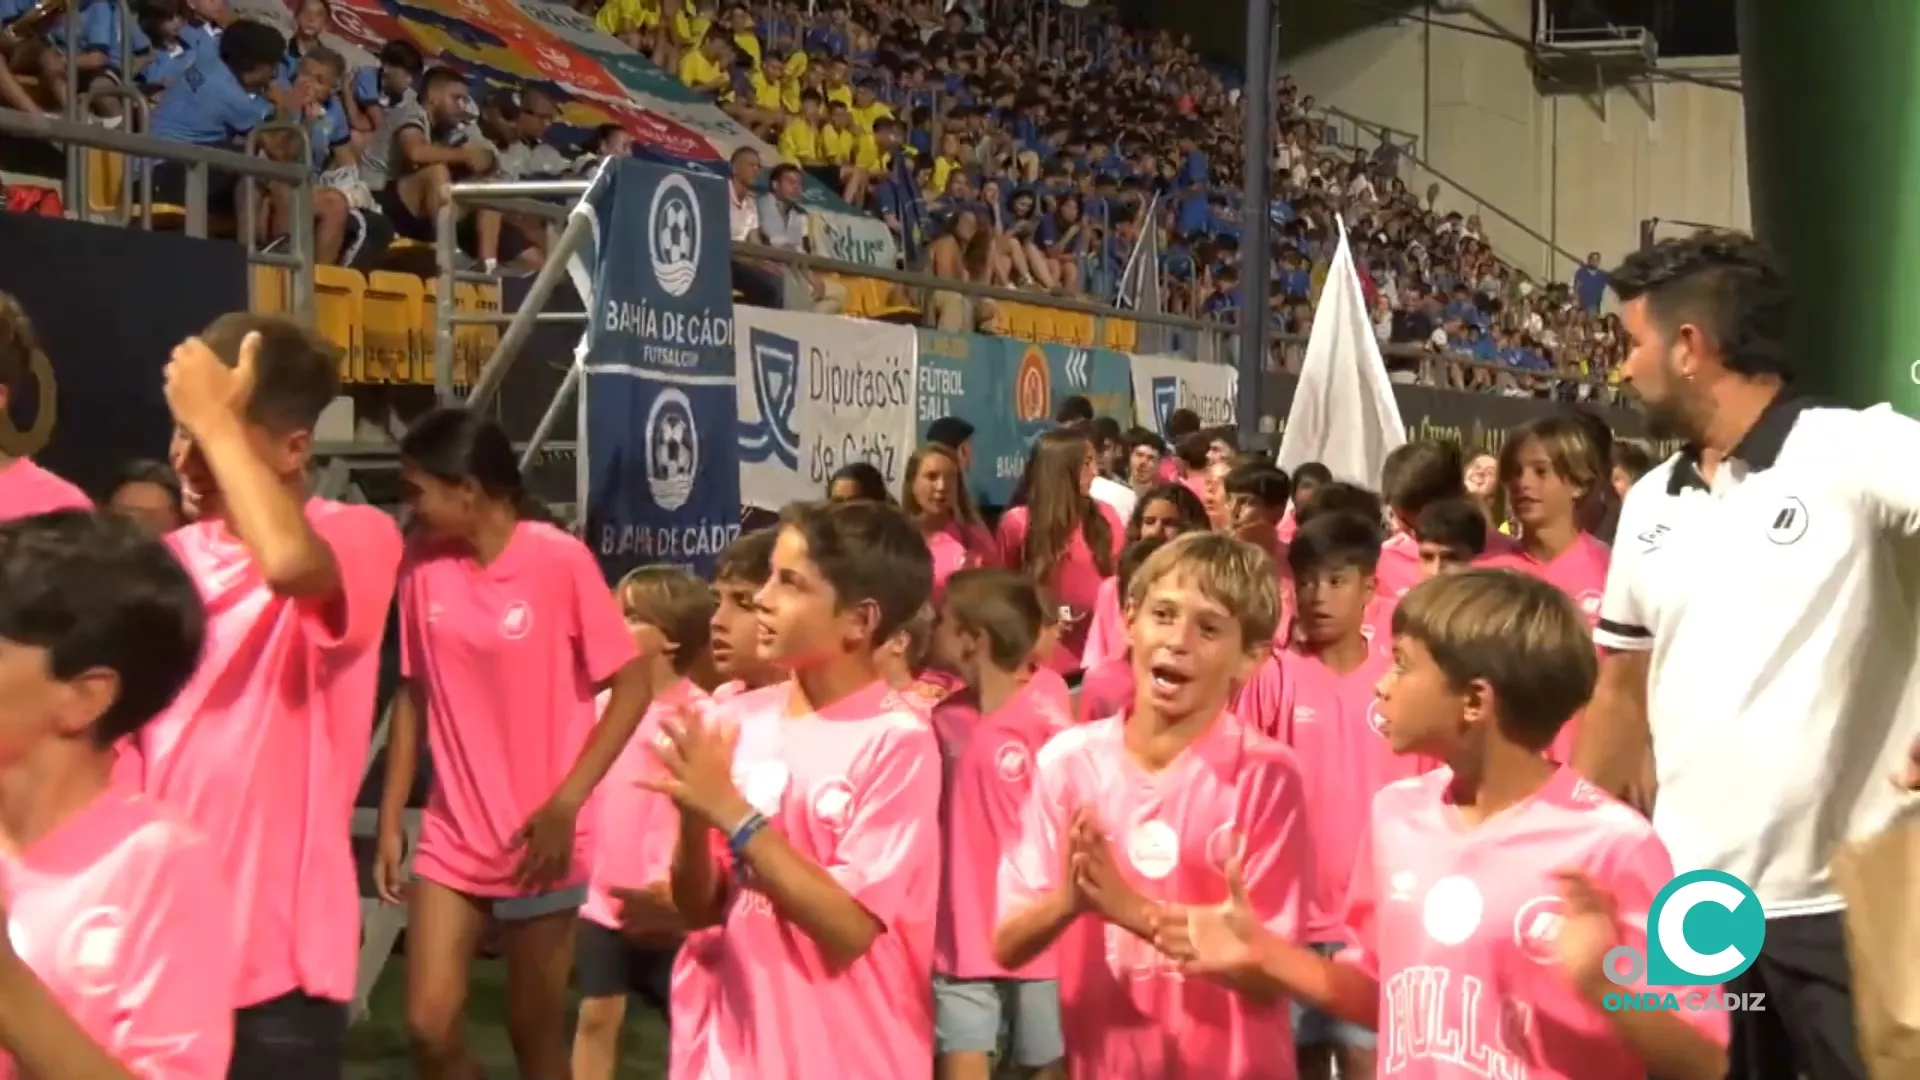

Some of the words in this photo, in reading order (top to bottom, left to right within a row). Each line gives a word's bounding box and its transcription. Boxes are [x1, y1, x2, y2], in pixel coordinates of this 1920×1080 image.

[605, 297, 658, 340] BAHÍA
[662, 311, 686, 344] DE
[919, 361, 964, 396] FÚTBOL
